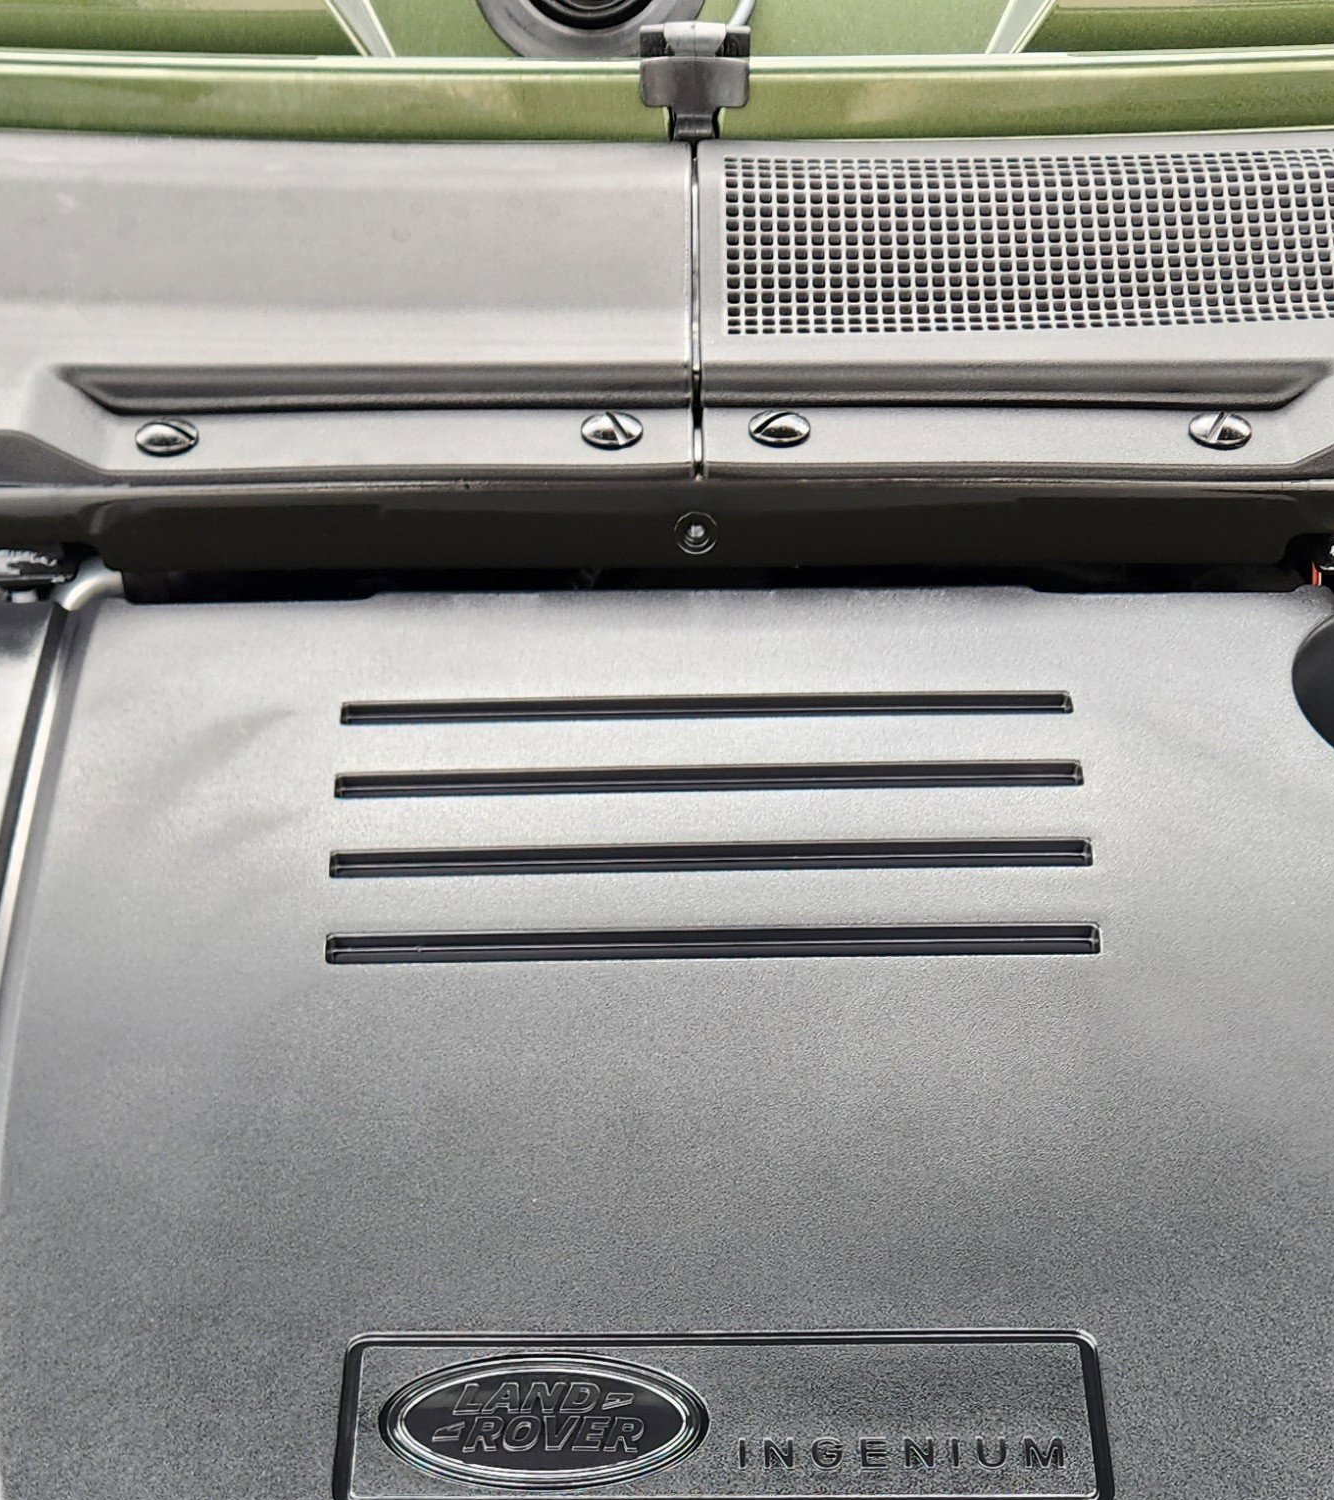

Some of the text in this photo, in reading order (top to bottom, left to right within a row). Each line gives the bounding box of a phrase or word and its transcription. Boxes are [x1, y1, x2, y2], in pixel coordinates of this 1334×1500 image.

[452, 1381, 600, 1416] LAND
[462, 1415, 644, 1453] ROVER
[738, 1436, 1067, 1470] INGENIUM
